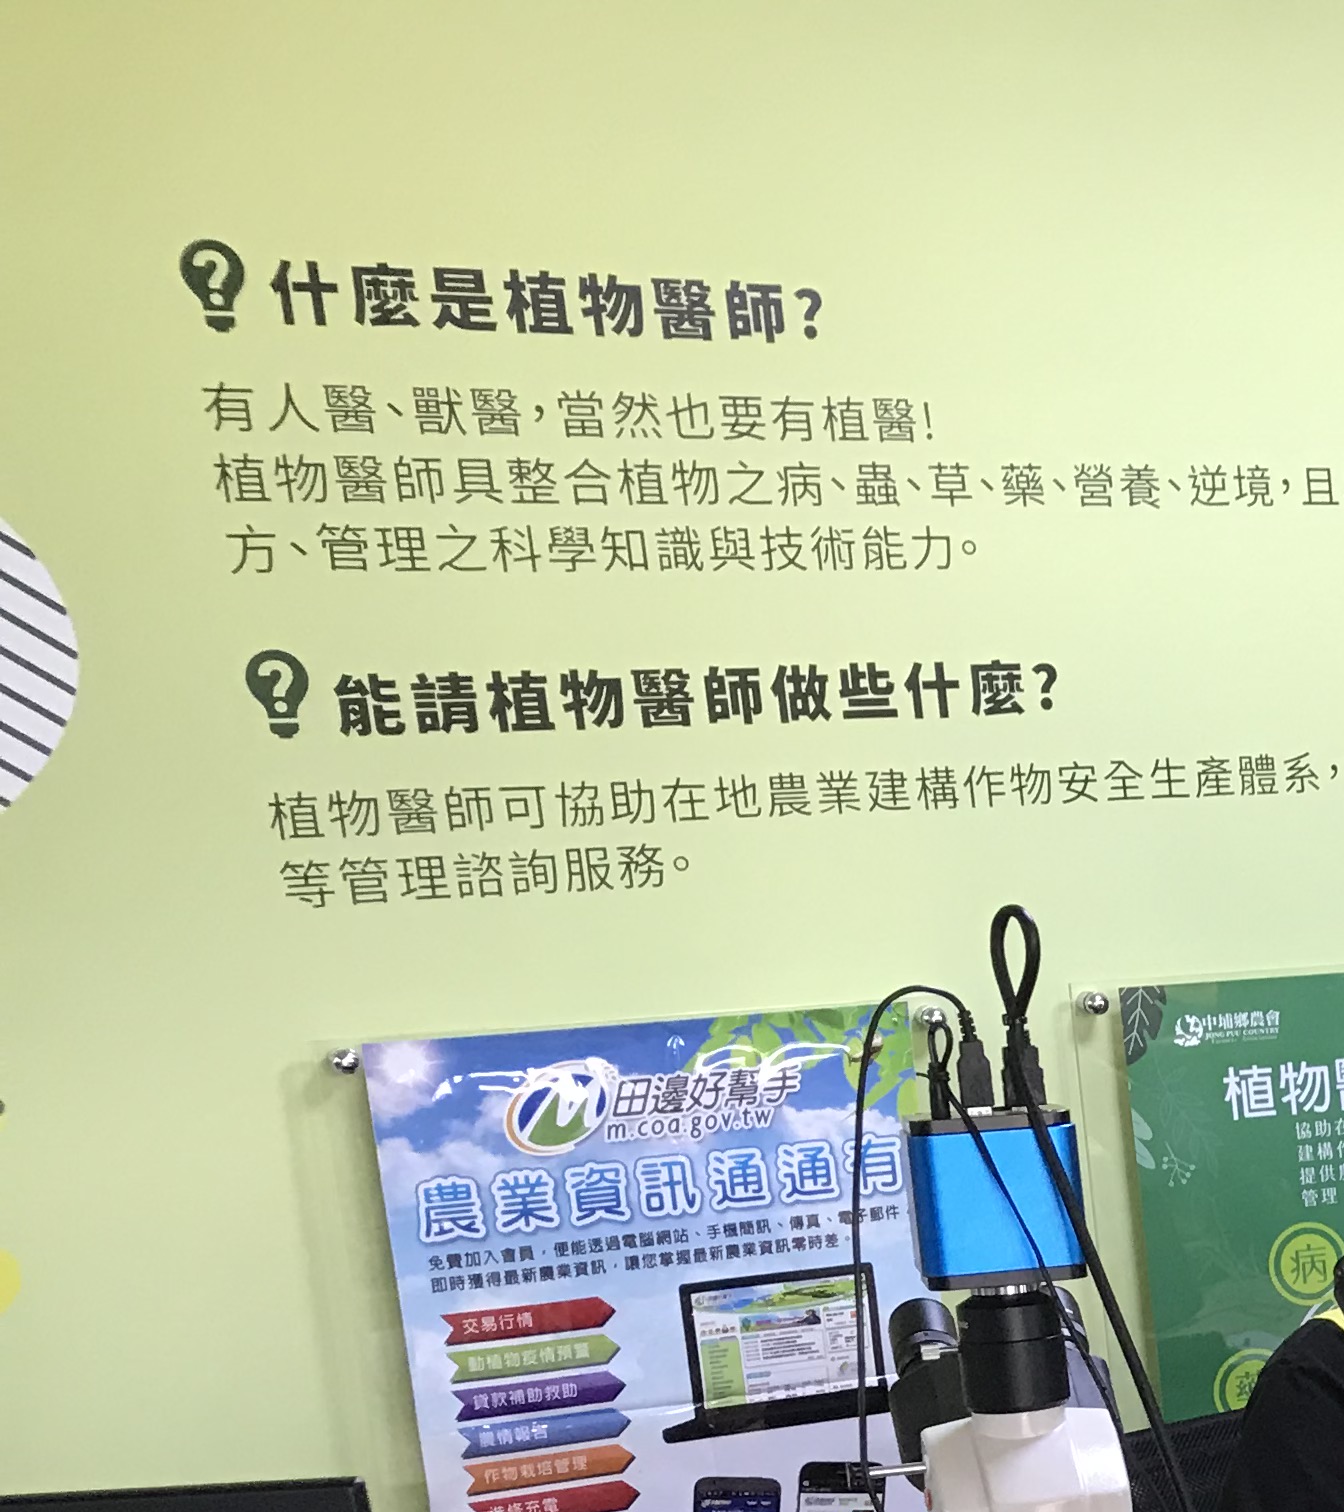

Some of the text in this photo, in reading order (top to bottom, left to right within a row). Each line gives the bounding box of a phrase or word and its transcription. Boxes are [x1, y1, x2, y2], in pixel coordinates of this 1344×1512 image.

[269, 259, 823, 344] 什麼是植物醫師?
[201, 381, 934, 443] 有人醫、獸醫，當然也要有植醫!
[226, 522, 978, 575] 方、管理之科學知識與技術能力。
[333, 659, 1058, 738] 能請植物醫師做些什麼?
[279, 841, 692, 909] 等管理諮詢服務。
[612, 1064, 800, 1119] 田邊好幫手
[607, 1106, 774, 1141] m.coa.gov.tw
[419, 1136, 905, 1242] 農業資訊通通有
[1289, 1243, 1328, 1285] 病
[462, 1312, 534, 1335] 交易行情
[473, 1383, 578, 1411] 貸款補助救助
[484, 1455, 588, 1485] 作物栽培管理
